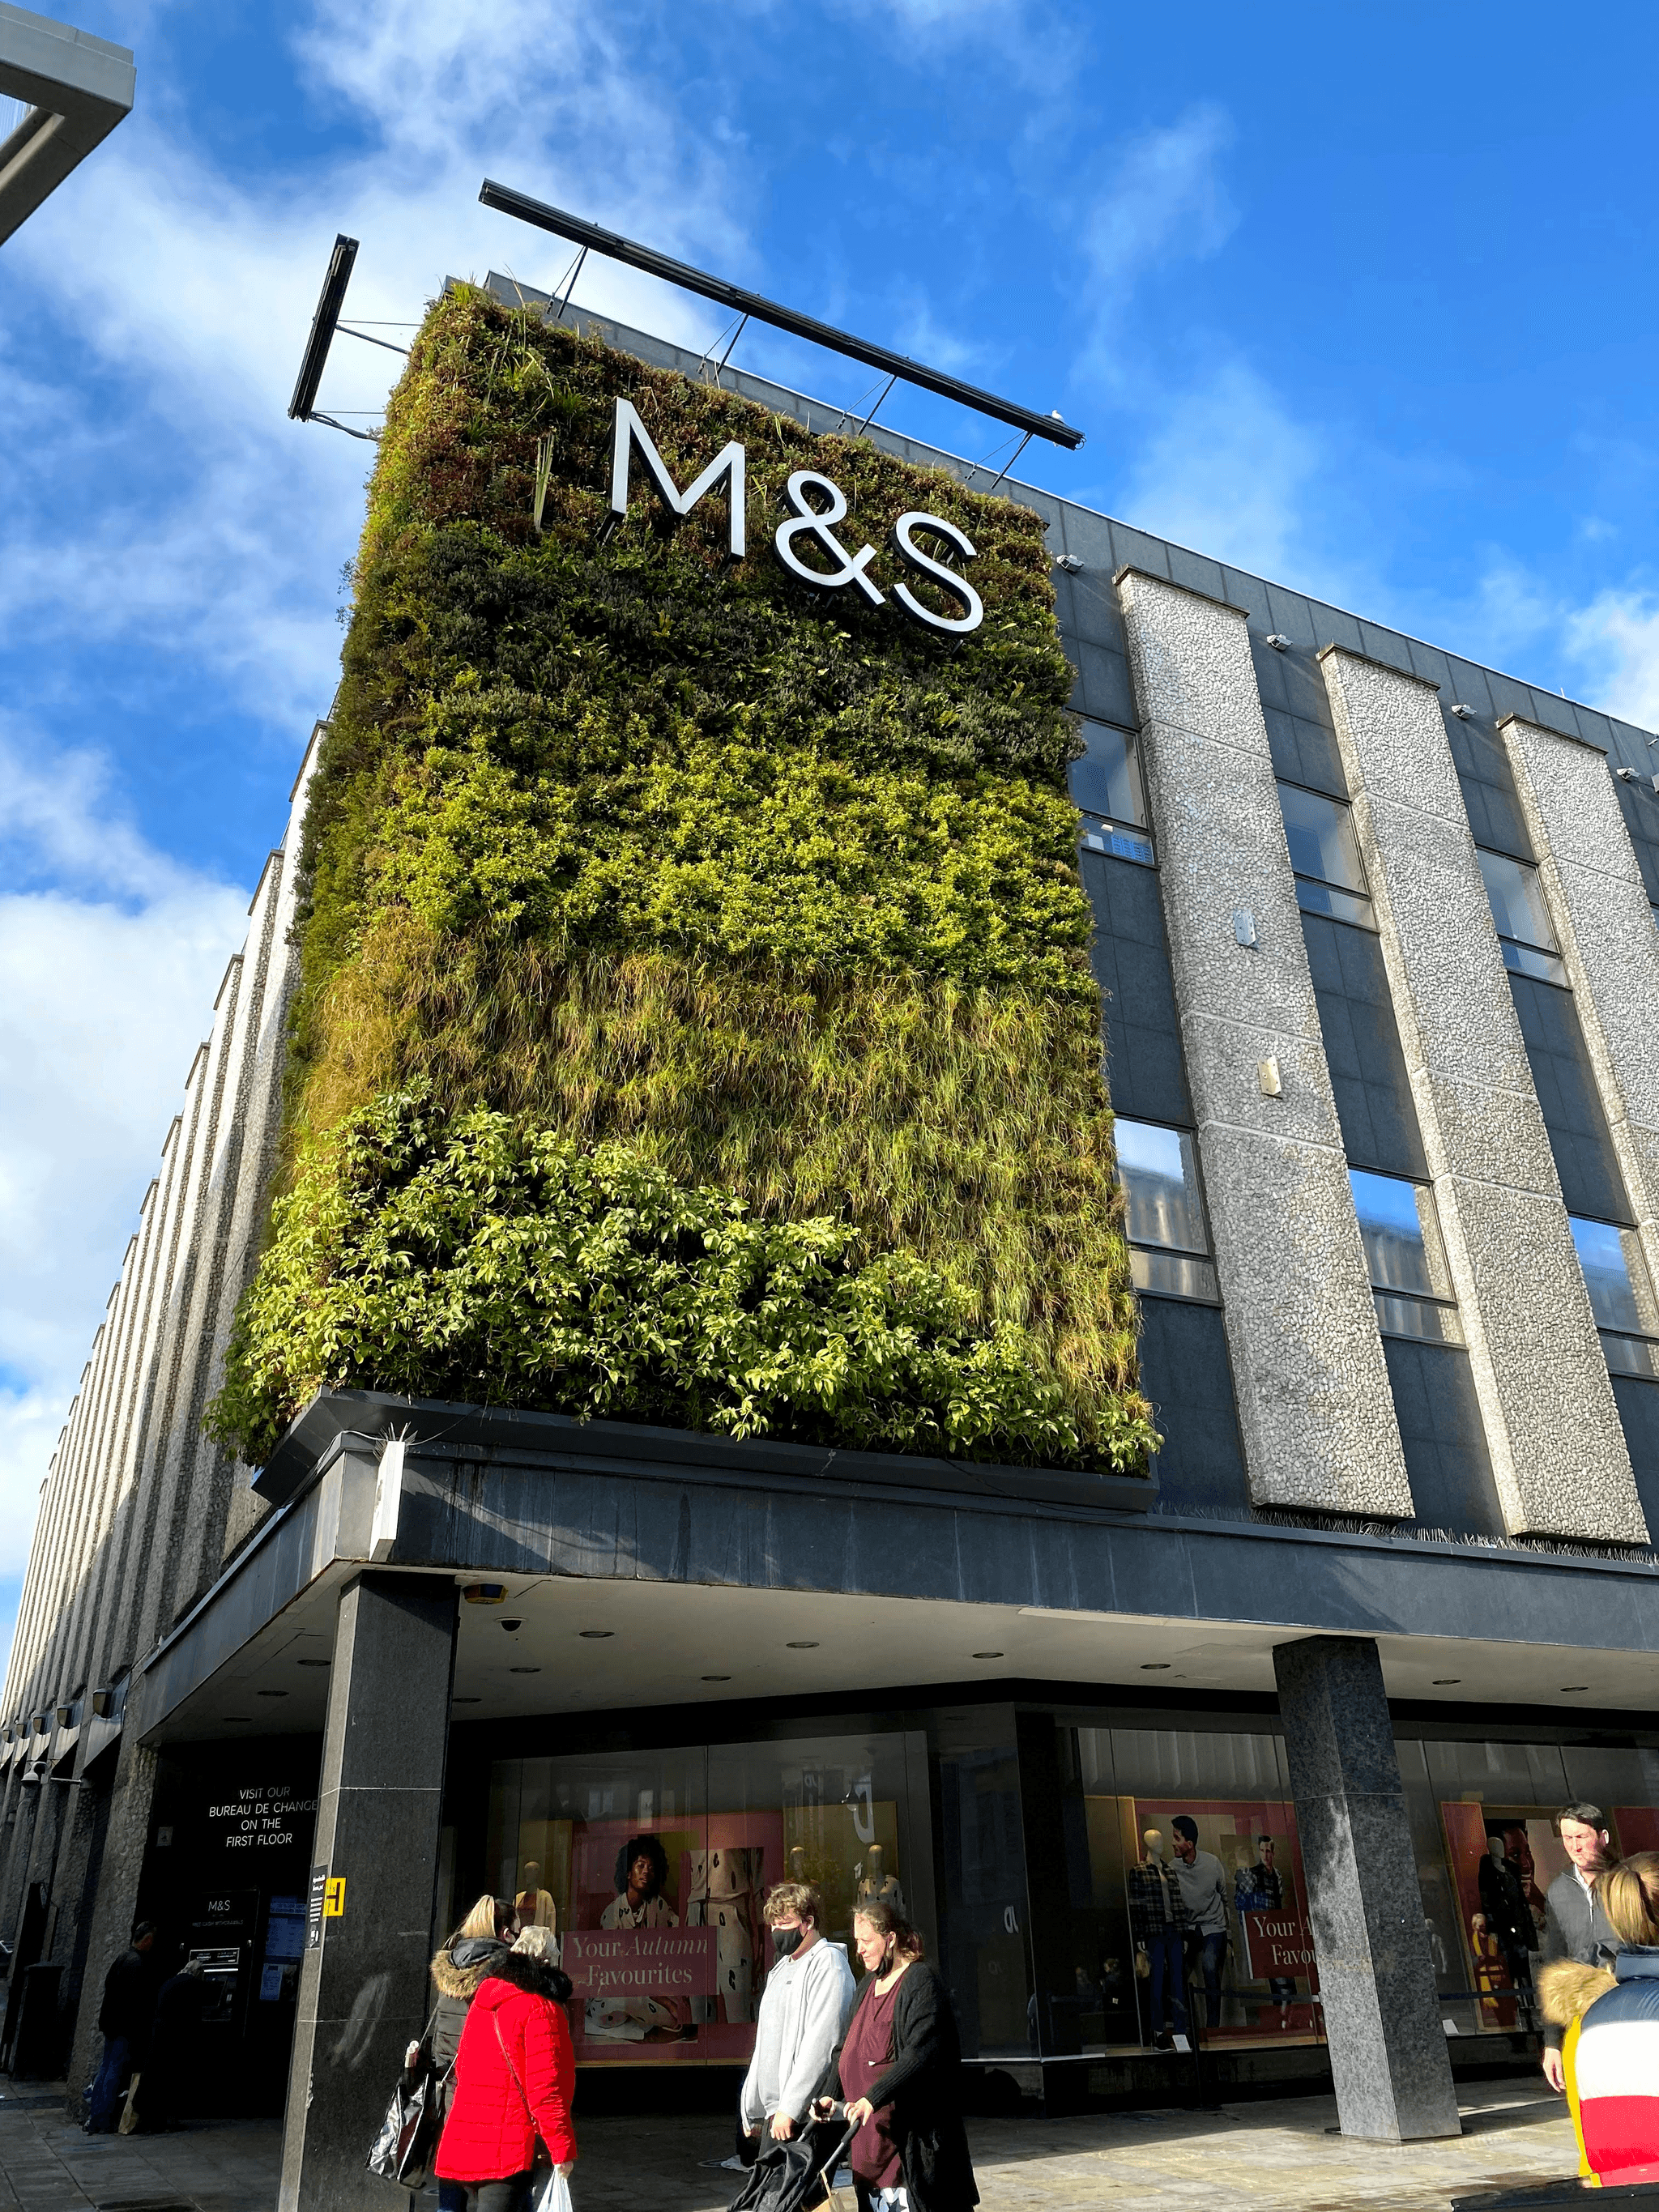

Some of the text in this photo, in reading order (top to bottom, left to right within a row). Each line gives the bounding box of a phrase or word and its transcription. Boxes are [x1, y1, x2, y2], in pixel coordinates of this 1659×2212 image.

[611, 396, 984, 633] M&S
[239, 1786, 291, 1800] VISIT OUR
[209, 1800, 318, 1818] BUREAU DE CHANGE
[241, 1818, 282, 1831] ON THE
[226, 1833, 292, 1848] FIRST FLOOR
[207, 1899, 231, 1912] M&S
[1252, 1916, 1296, 1937] Your
[572, 1935, 708, 1958] Your Autumn
[587, 1962, 693, 1986] Favourites
